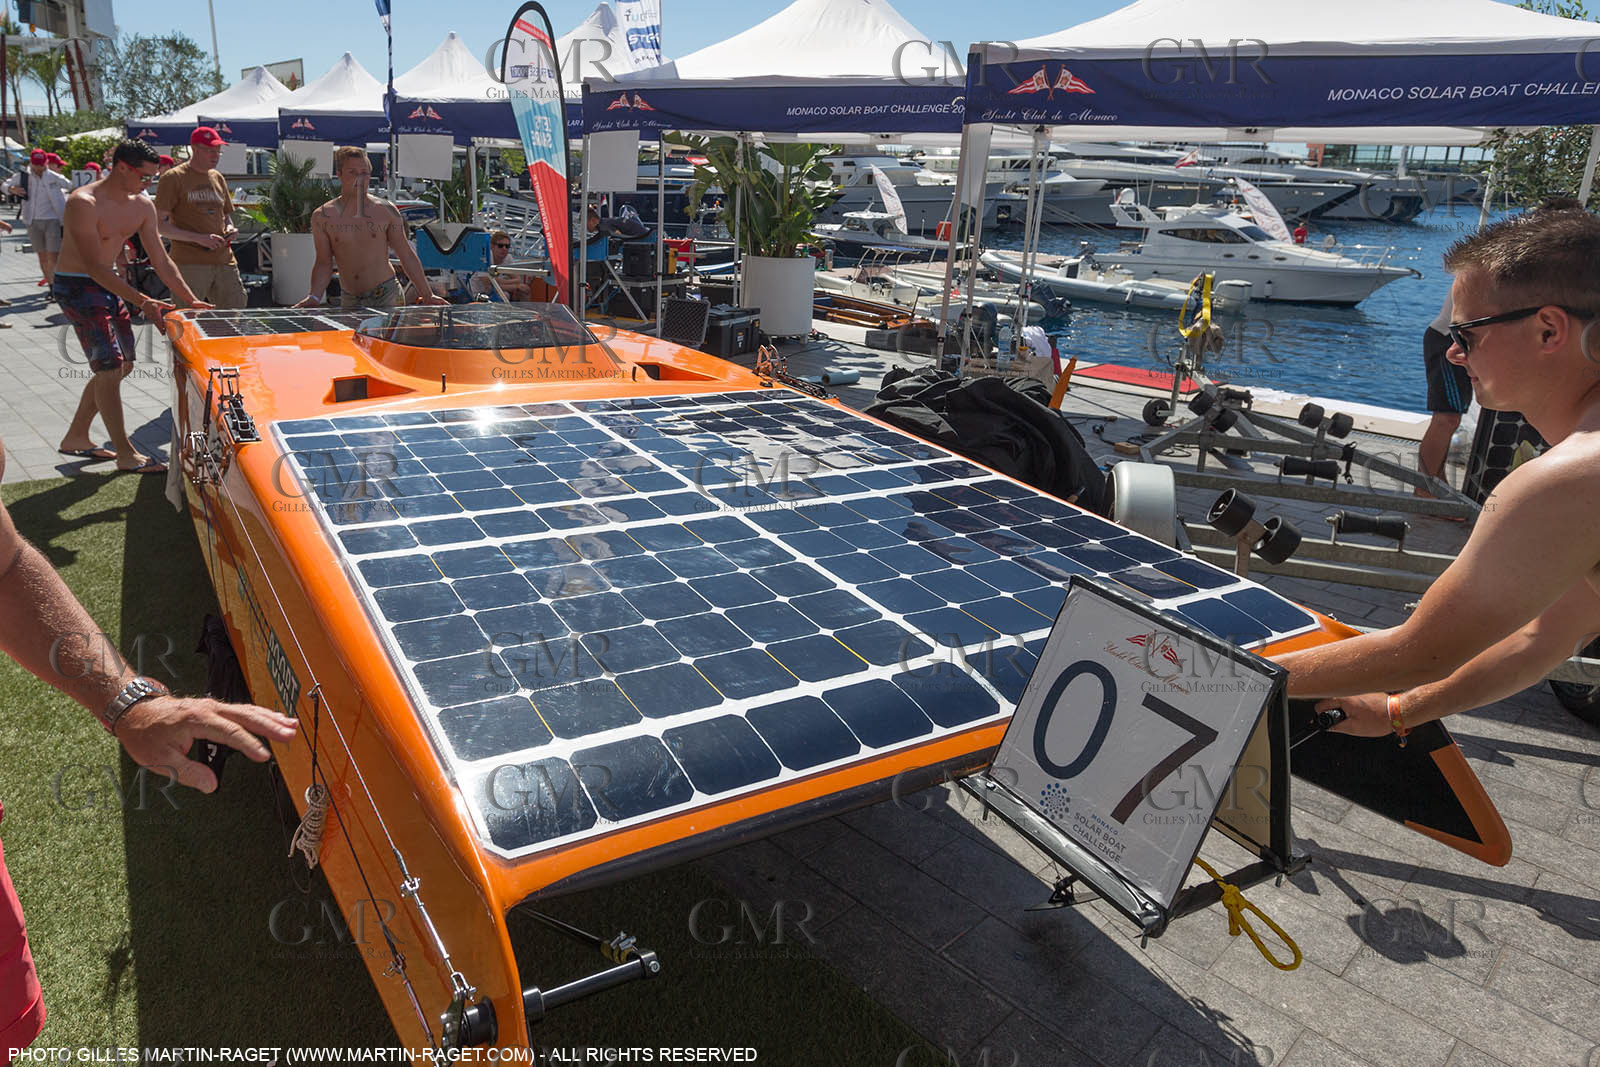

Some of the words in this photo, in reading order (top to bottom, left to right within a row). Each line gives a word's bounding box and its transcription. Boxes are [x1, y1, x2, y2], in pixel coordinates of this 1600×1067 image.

[1327, 88, 1404, 101] MONACO
[1407, 86, 1466, 100] SOLAR
[1469, 83, 1521, 99] BOAT
[787, 107, 828, 116] MONACO
[829, 106, 862, 115] SOLAR
[863, 105, 889, 114] BOAT
[890, 104, 951, 114] CHALLENGE
[952, 104, 965, 114] 20
[981, 107, 1017, 121] Yacht
[1020, 106, 1047, 121] Club
[1051, 109, 1063, 121] de
[1068, 107, 1119, 121] Monaco
[75, 171, 93, 187] 12
[1033, 660, 1219, 825] 07
[1073, 811, 1103, 836] SOLAR
[1102, 832, 1127, 854] BOAT
[1091, 813, 1120, 836] MONACO
[1072, 823, 1122, 864] CHALLENGE
